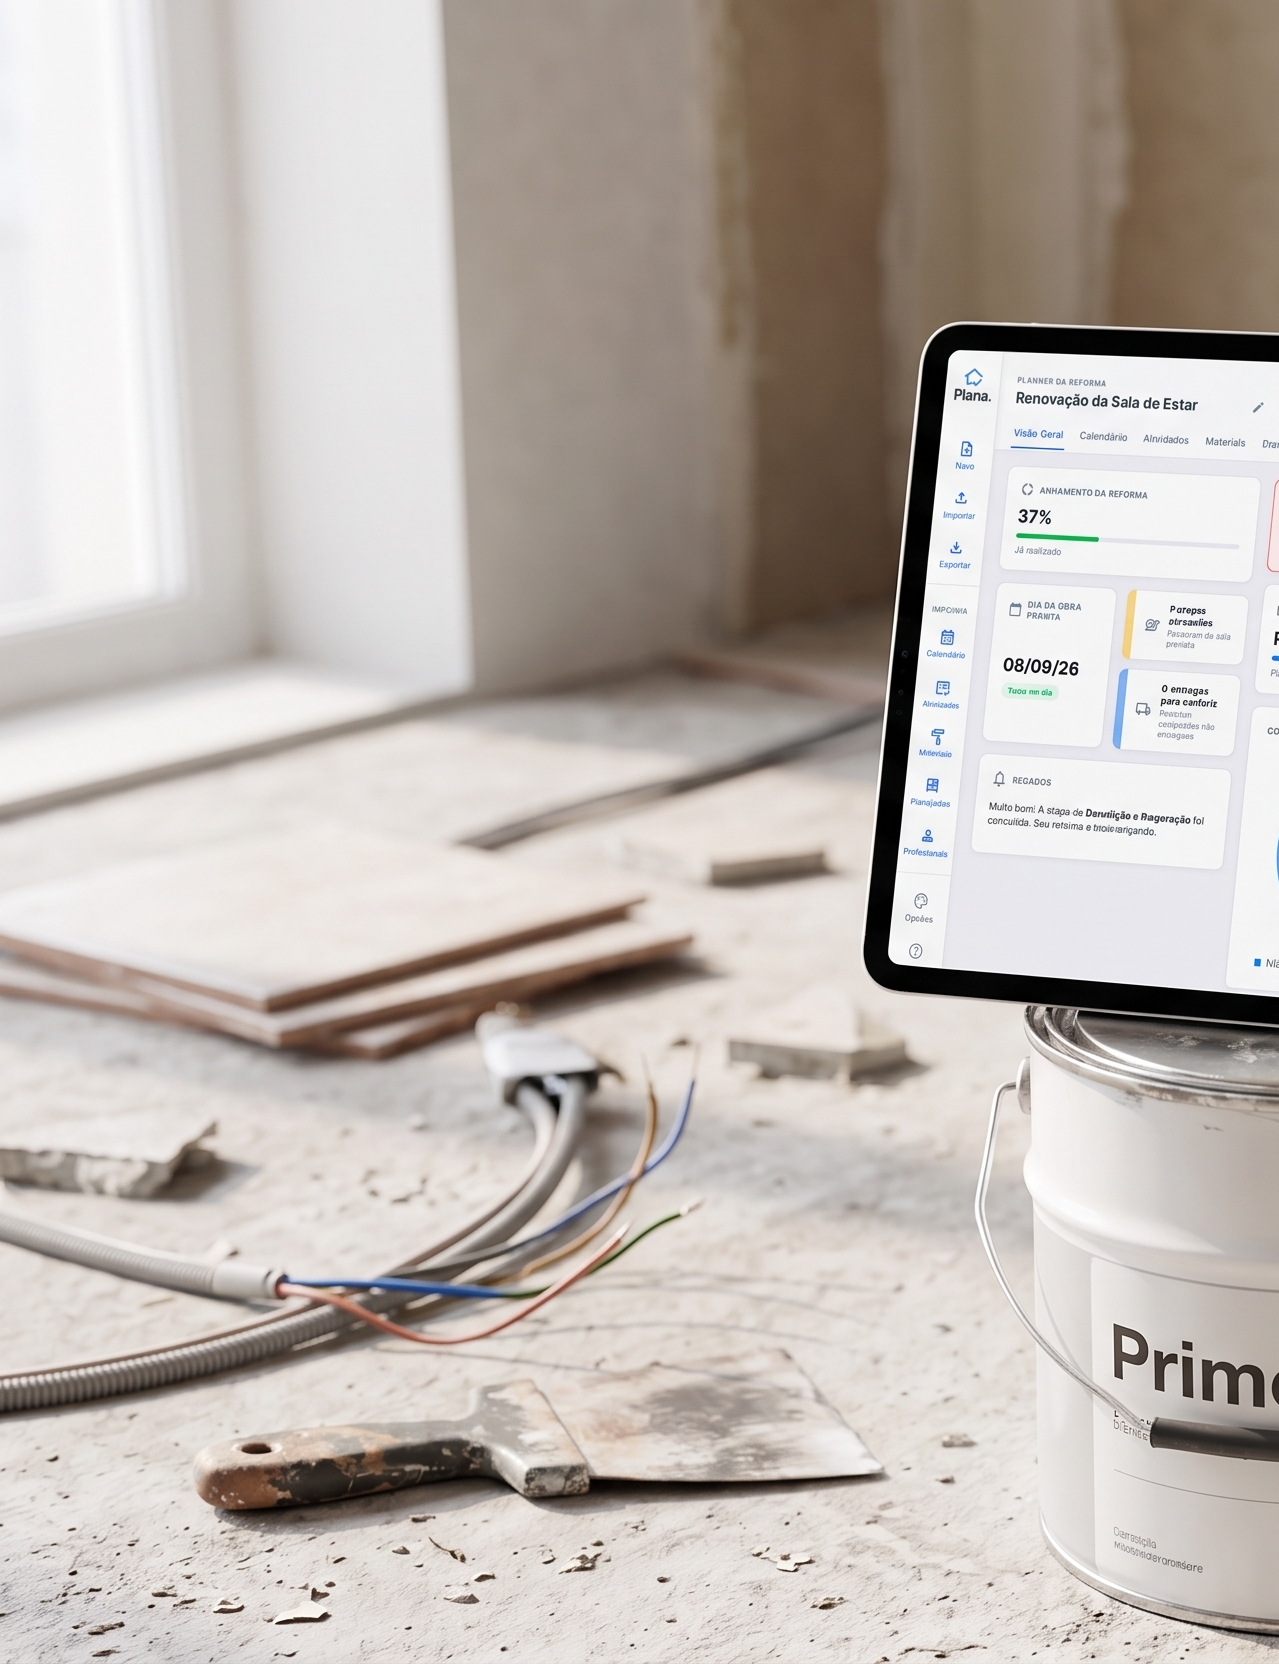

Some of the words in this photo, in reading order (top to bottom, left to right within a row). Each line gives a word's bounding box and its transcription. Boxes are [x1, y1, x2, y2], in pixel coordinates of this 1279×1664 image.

[1069, 379, 1106, 387] REFORMA
[954, 388, 991, 402] Plana.
[1016, 392, 1088, 409] Renovação
[1092, 395, 1108, 407] da
[1112, 396, 1139, 408] Sala
[1143, 397, 1160, 409] de
[1163, 398, 1198, 411] Estar
[1041, 430, 1063, 438] Geral
[1109, 490, 1147, 499] REFORMA
[1018, 509, 1051, 524] 37%
[1004, 658, 1079, 676] 08/09/26
